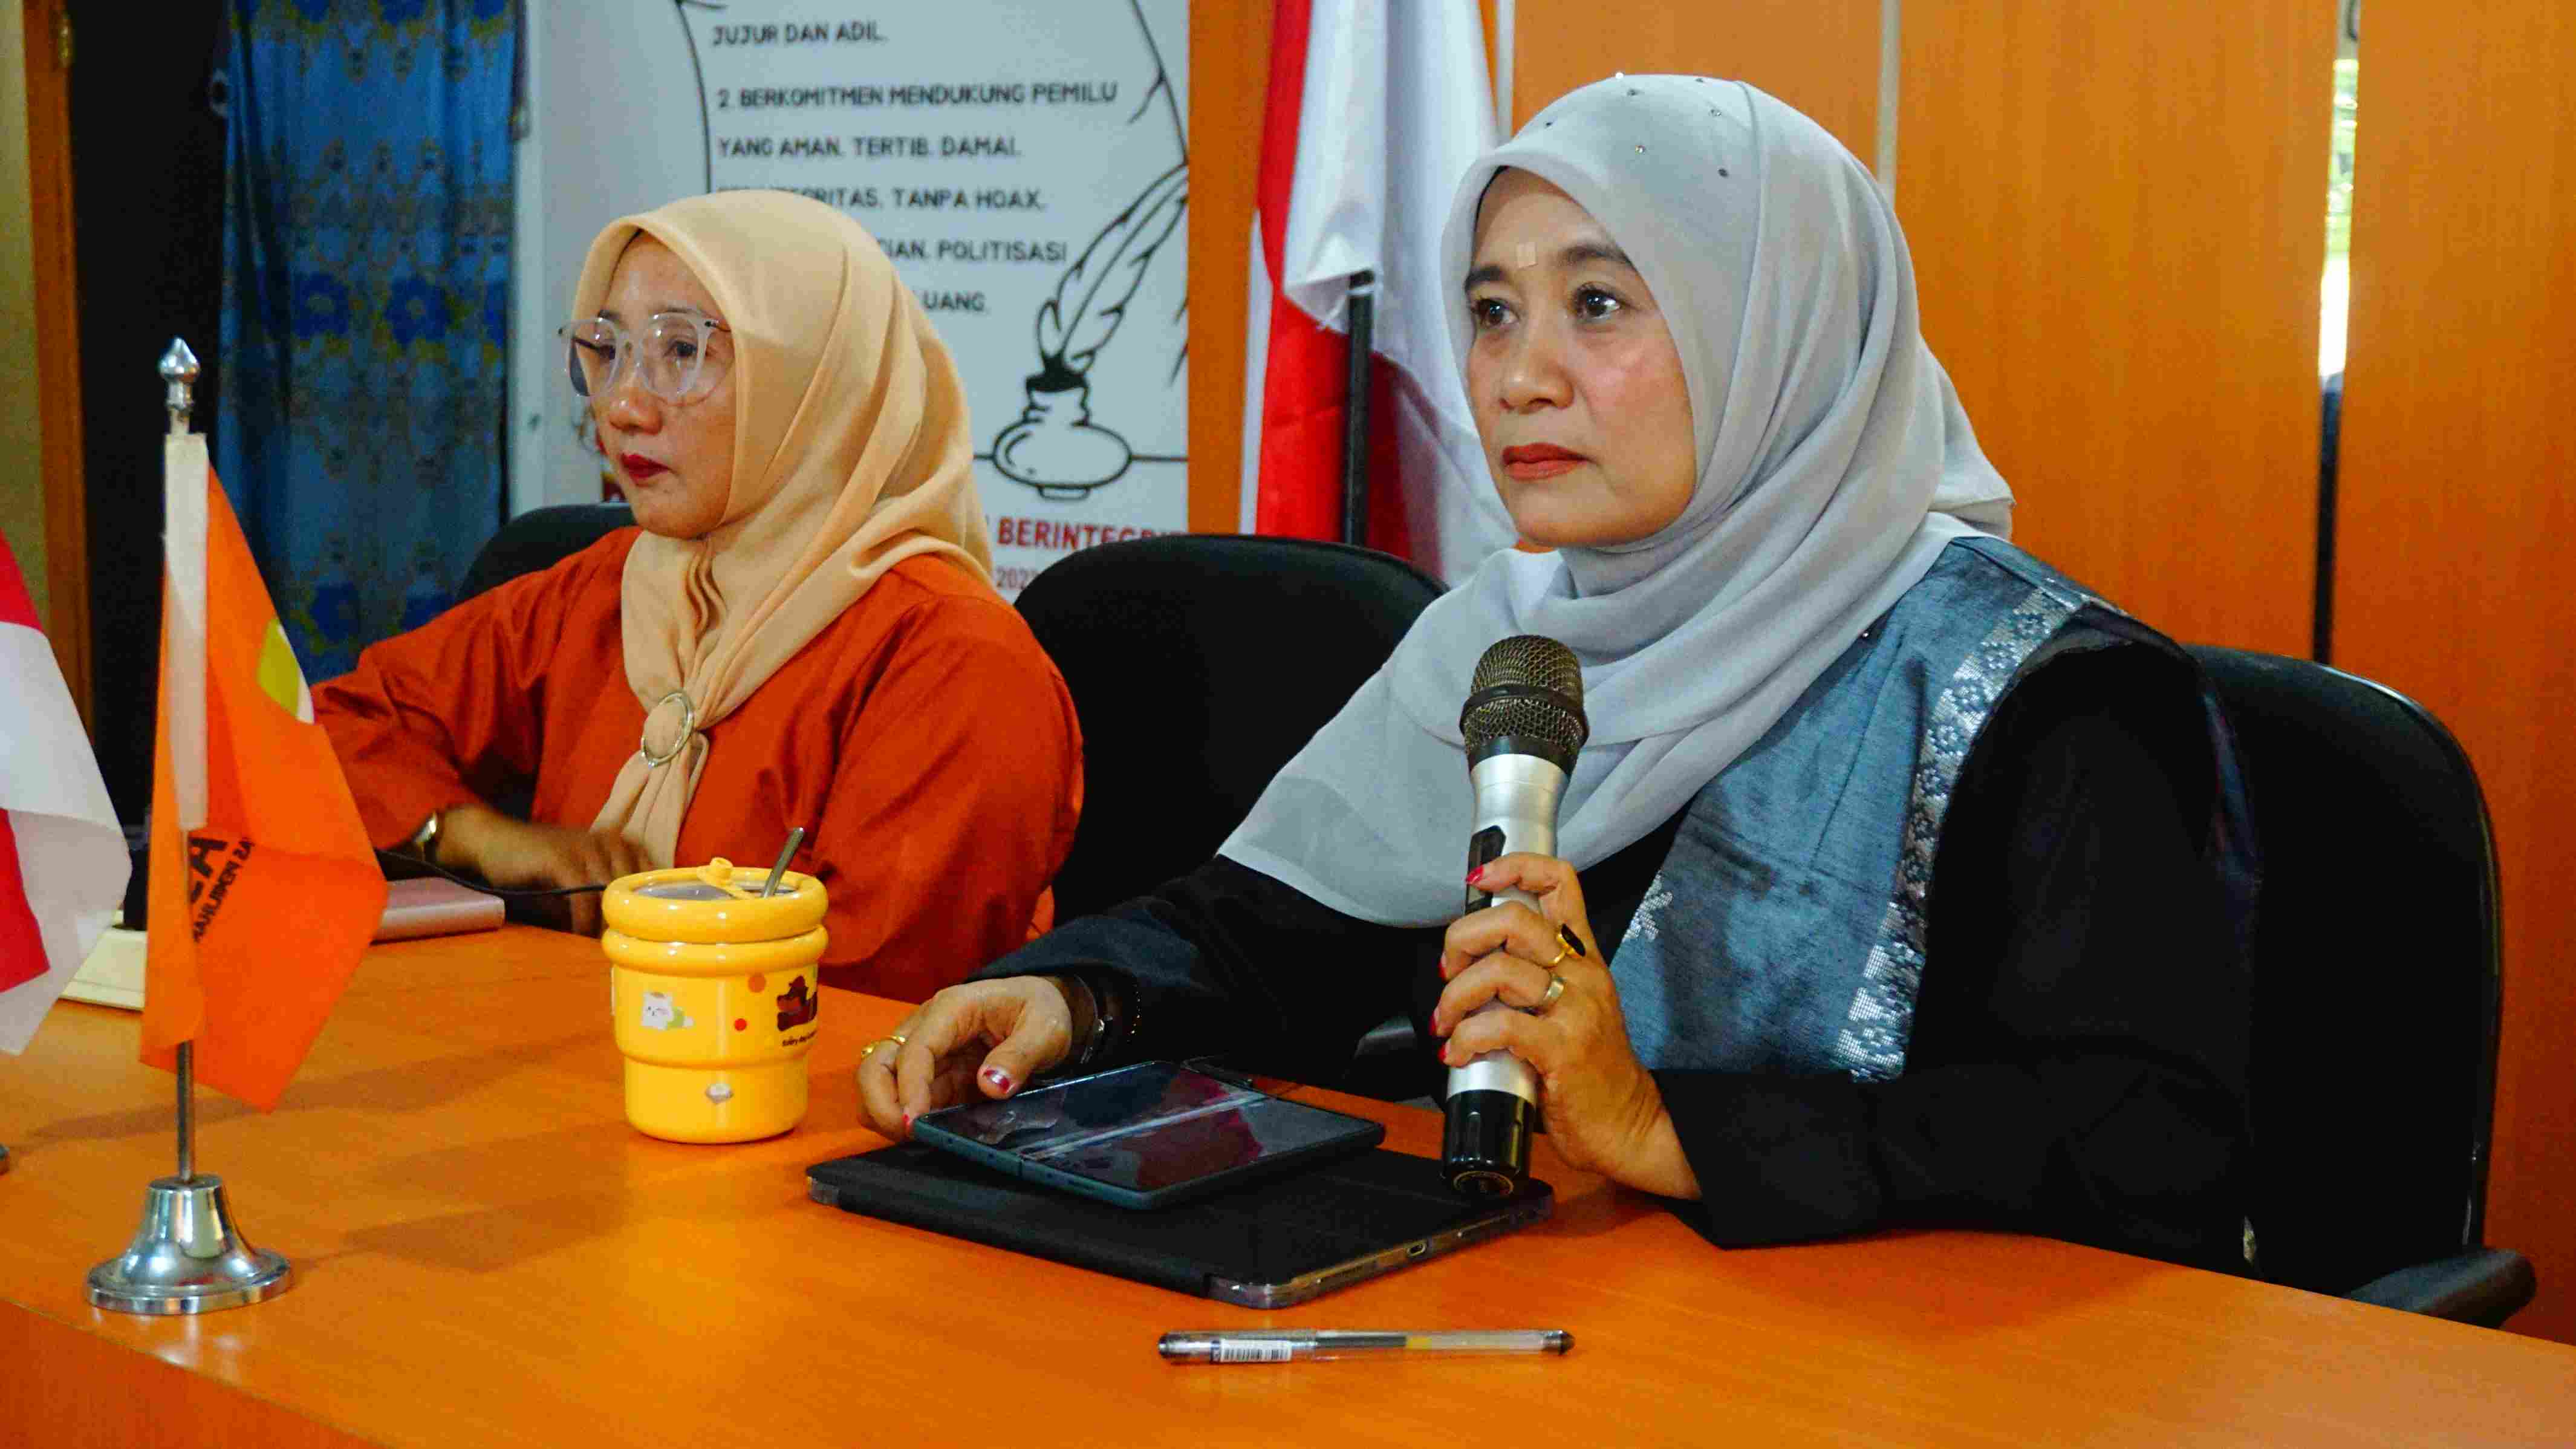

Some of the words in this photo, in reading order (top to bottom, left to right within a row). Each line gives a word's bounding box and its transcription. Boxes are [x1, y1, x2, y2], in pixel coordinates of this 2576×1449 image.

[713, 24, 778, 47] JUJUR
[785, 22, 829, 44] DAN
[739, 85, 883, 108] BERKOMITMEN
[890, 83, 1026, 105] MENDUKUNG
[1032, 81, 1118, 103] PEMILU
[718, 136, 773, 157] YANG
[892, 186, 969, 209] TANPA
[937, 238, 1068, 262] POLITISASI
